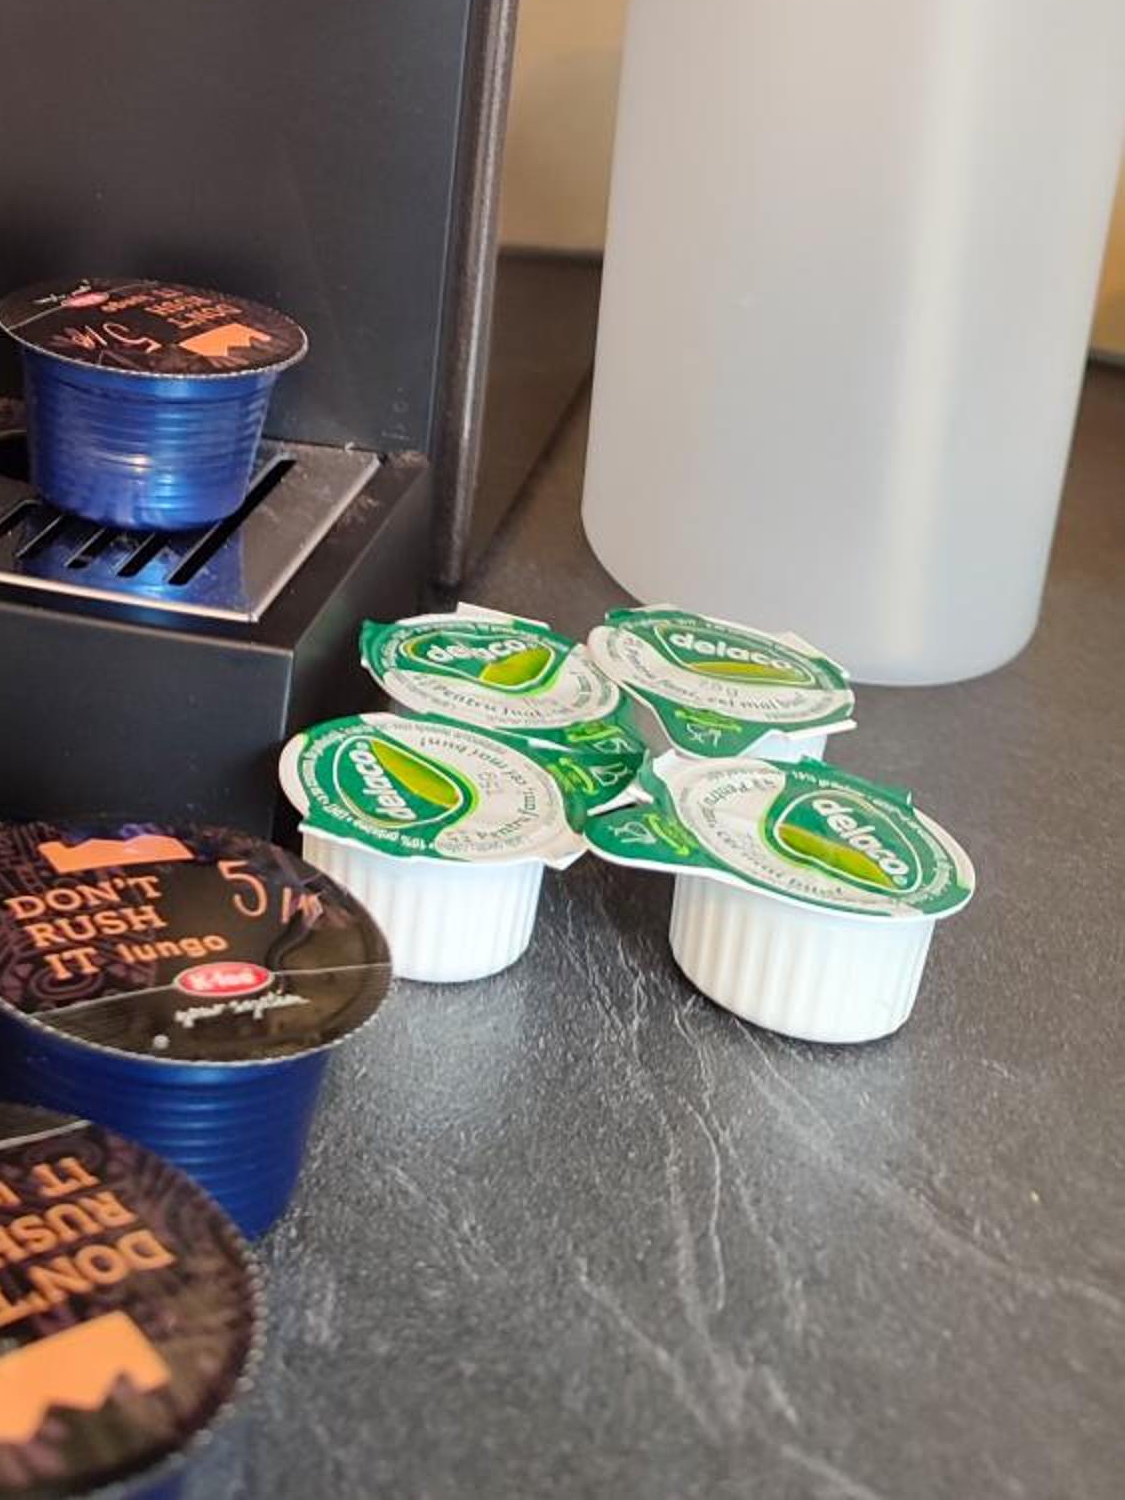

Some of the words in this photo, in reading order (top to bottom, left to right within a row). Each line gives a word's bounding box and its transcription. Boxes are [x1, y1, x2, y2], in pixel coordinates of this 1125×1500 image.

[425, 639, 527, 663] delaco
[669, 631, 793, 671] delaco
[348, 748, 418, 820] delaco
[810, 798, 910, 878] delaco
[3, 874, 163, 921] DON'T
[24, 906, 167, 950] RUSH
[43, 946, 101, 982] IT
[115, 933, 229, 965] lungo
[30, 1155, 100, 1197] IT
